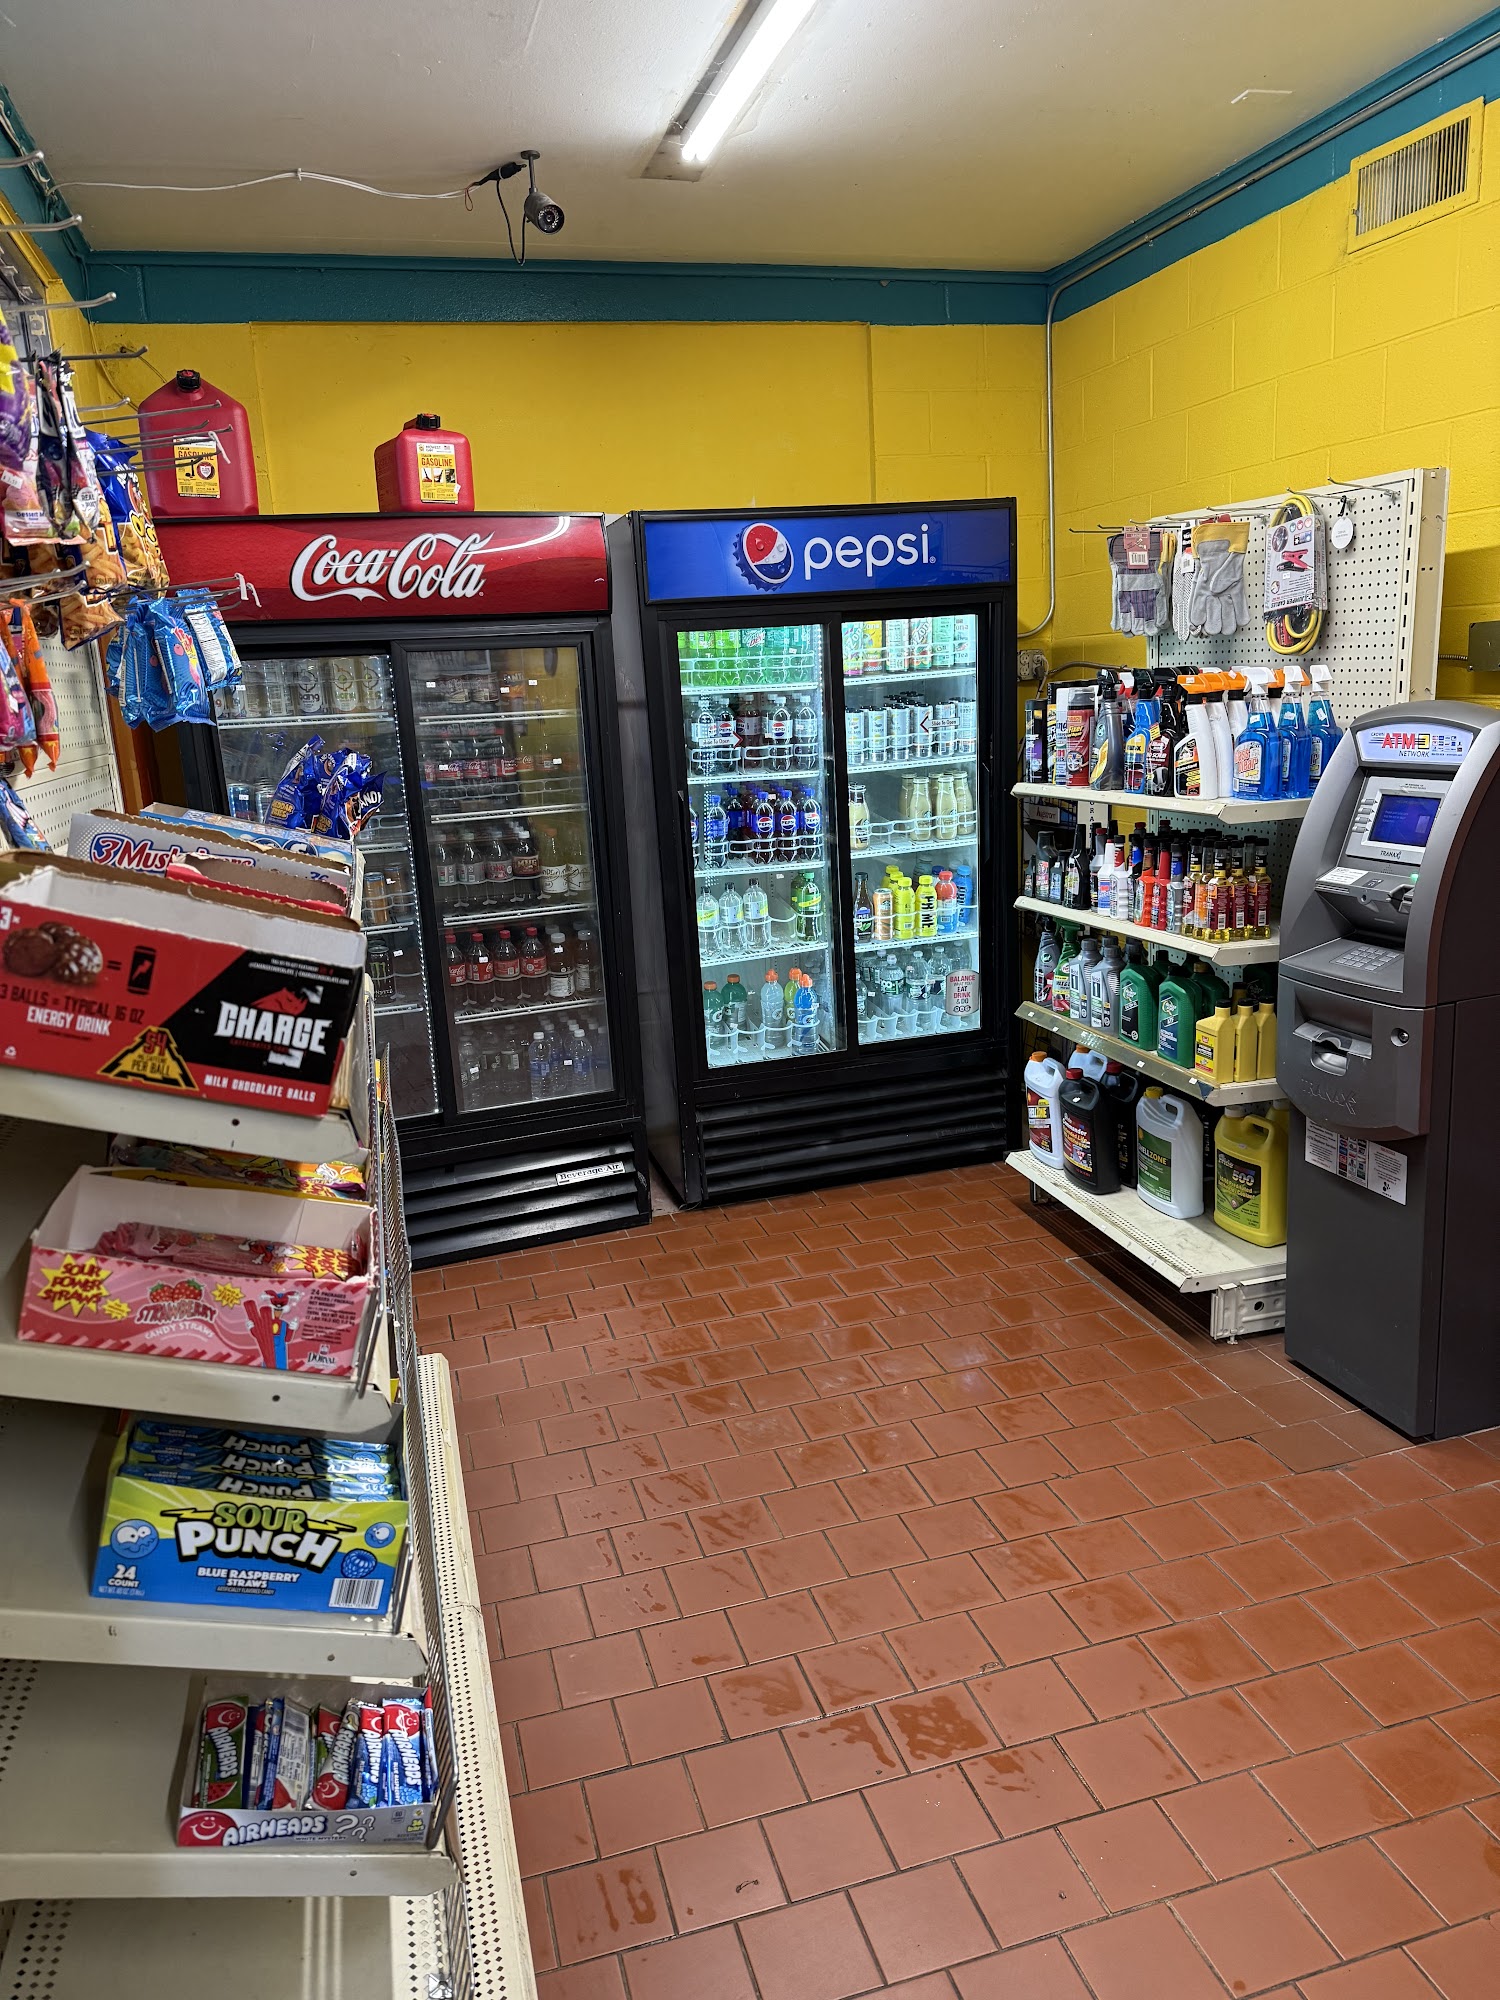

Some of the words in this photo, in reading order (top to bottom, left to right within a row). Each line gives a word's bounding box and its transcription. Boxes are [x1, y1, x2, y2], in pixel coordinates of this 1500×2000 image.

[421, 457, 453, 467] GASOLINE
[804, 523, 930, 580] pepsi
[289, 531, 495, 602] Coca-Cola
[1382, 733, 1416, 750] ATM
[1398, 750, 1430, 758] NETWORK
[517, 858, 538, 868] MUG
[1380, 850, 1402, 860] TRANAX
[949, 974, 976, 983] BALANCE
[953, 991, 971, 999] DRINK
[11, 986, 49, 1006] BALLS
[64, 995, 110, 1019] TYPICAL
[115, 1005, 127, 1022] 16
[129, 1009, 145, 1025] OZ
[27, 1005, 75, 1030] ENERGY
[75, 1014, 112, 1036] DRINK
[214, 1000, 333, 1055] CHARGE
[131, 1058, 148, 1074] PER
[150, 1060, 171, 1077] BALL
[203, 1073, 229, 1089] MILK
[231, 1077, 284, 1098] CHOCOLATE
[286, 1089, 316, 1103] BALLS
[1231, 1169, 1255, 1187] 500
[62, 1262, 103, 1278] SOUR
[51, 1276, 103, 1292] POWER
[310, 1288, 320, 1296] 24
[43, 1288, 103, 1304] STRAWS
[136, 1301, 218, 1325] STRAWBERRY
[144, 1324, 178, 1340] CANDY
[179, 1321, 216, 1338] STRAWS
[223, 1436, 312, 1456] PUNCH
[221, 1454, 316, 1475] PUNCH
[218, 1475, 316, 1499] PUNCH
[213, 1502, 307, 1533] SOUR
[176, 1520, 341, 1571] PUNCH
[113, 1564, 137, 1580] 24
[197, 1566, 228, 1579] BLUE
[229, 1568, 301, 1583] RASPBERRY
[107, 1579, 140, 1588] COUNT
[226, 1578, 268, 1589] STRAWS
[207, 1726, 239, 1779] AIRHEADS
[332, 1727, 355, 1785] AIRHEADS
[387, 1728, 422, 1787] AIRHEADS
[222, 1815, 328, 1847] AIRHEADS
